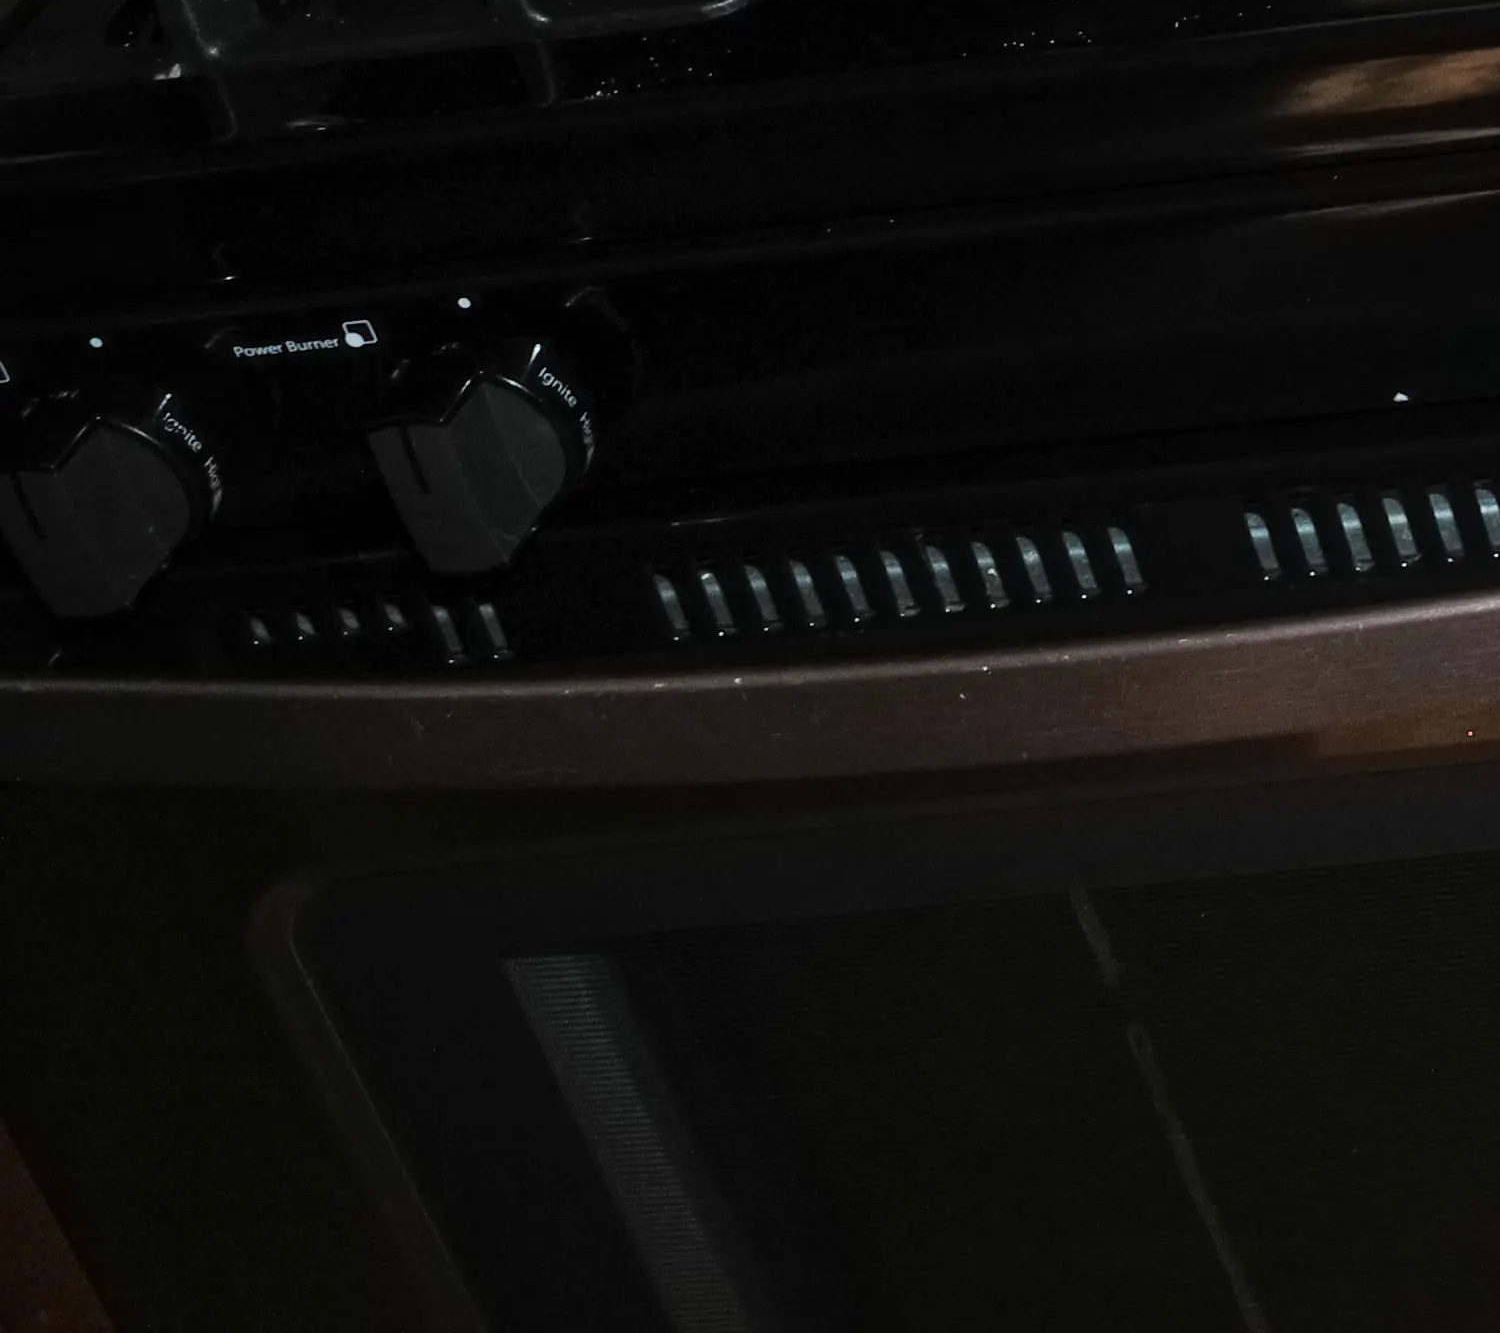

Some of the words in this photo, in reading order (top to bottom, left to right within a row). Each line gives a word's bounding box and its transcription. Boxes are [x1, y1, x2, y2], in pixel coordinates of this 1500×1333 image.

[232, 343, 283, 358] Power
[285, 338, 339, 353] Burner
[538, 366, 578, 408] Ignite
[163, 412, 203, 453] Ignite
